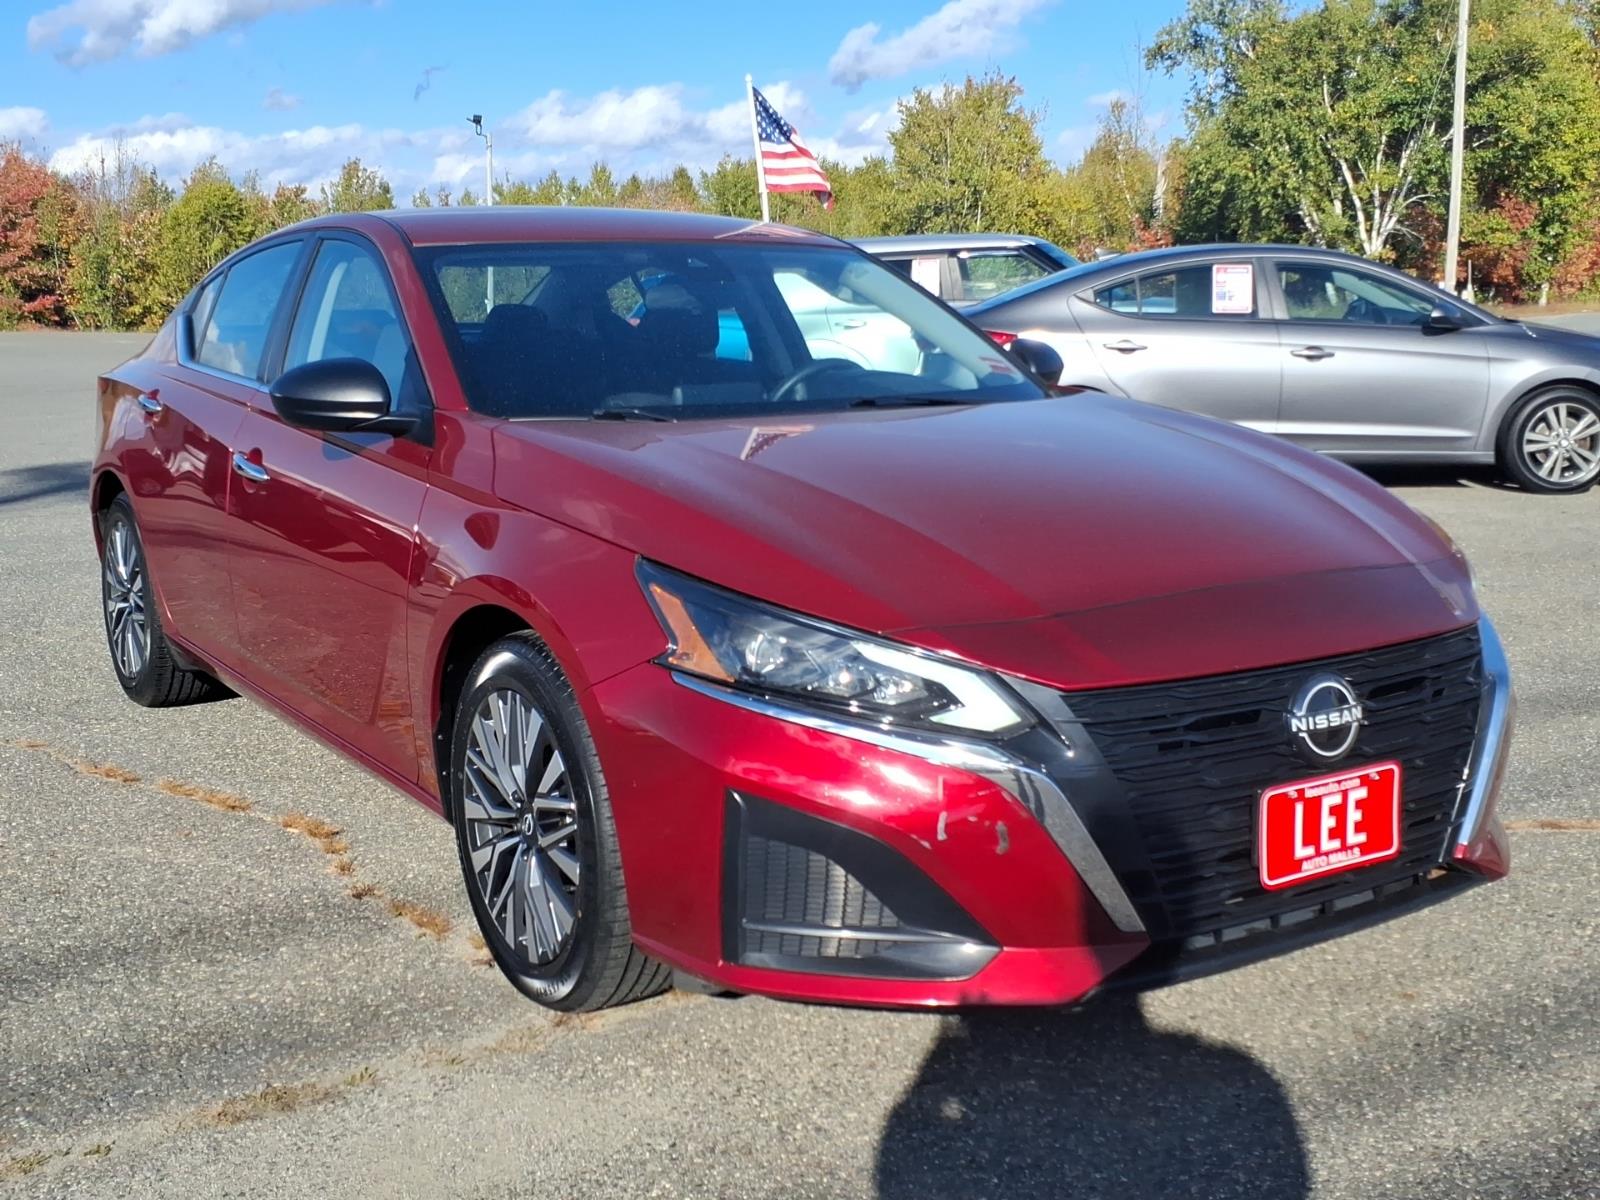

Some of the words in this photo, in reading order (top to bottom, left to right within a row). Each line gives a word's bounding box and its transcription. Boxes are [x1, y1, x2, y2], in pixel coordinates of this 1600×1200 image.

[1291, 705, 1363, 732] NISSAN
[1294, 786, 1368, 860] LEE
[1301, 854, 1328, 872] AUTO
